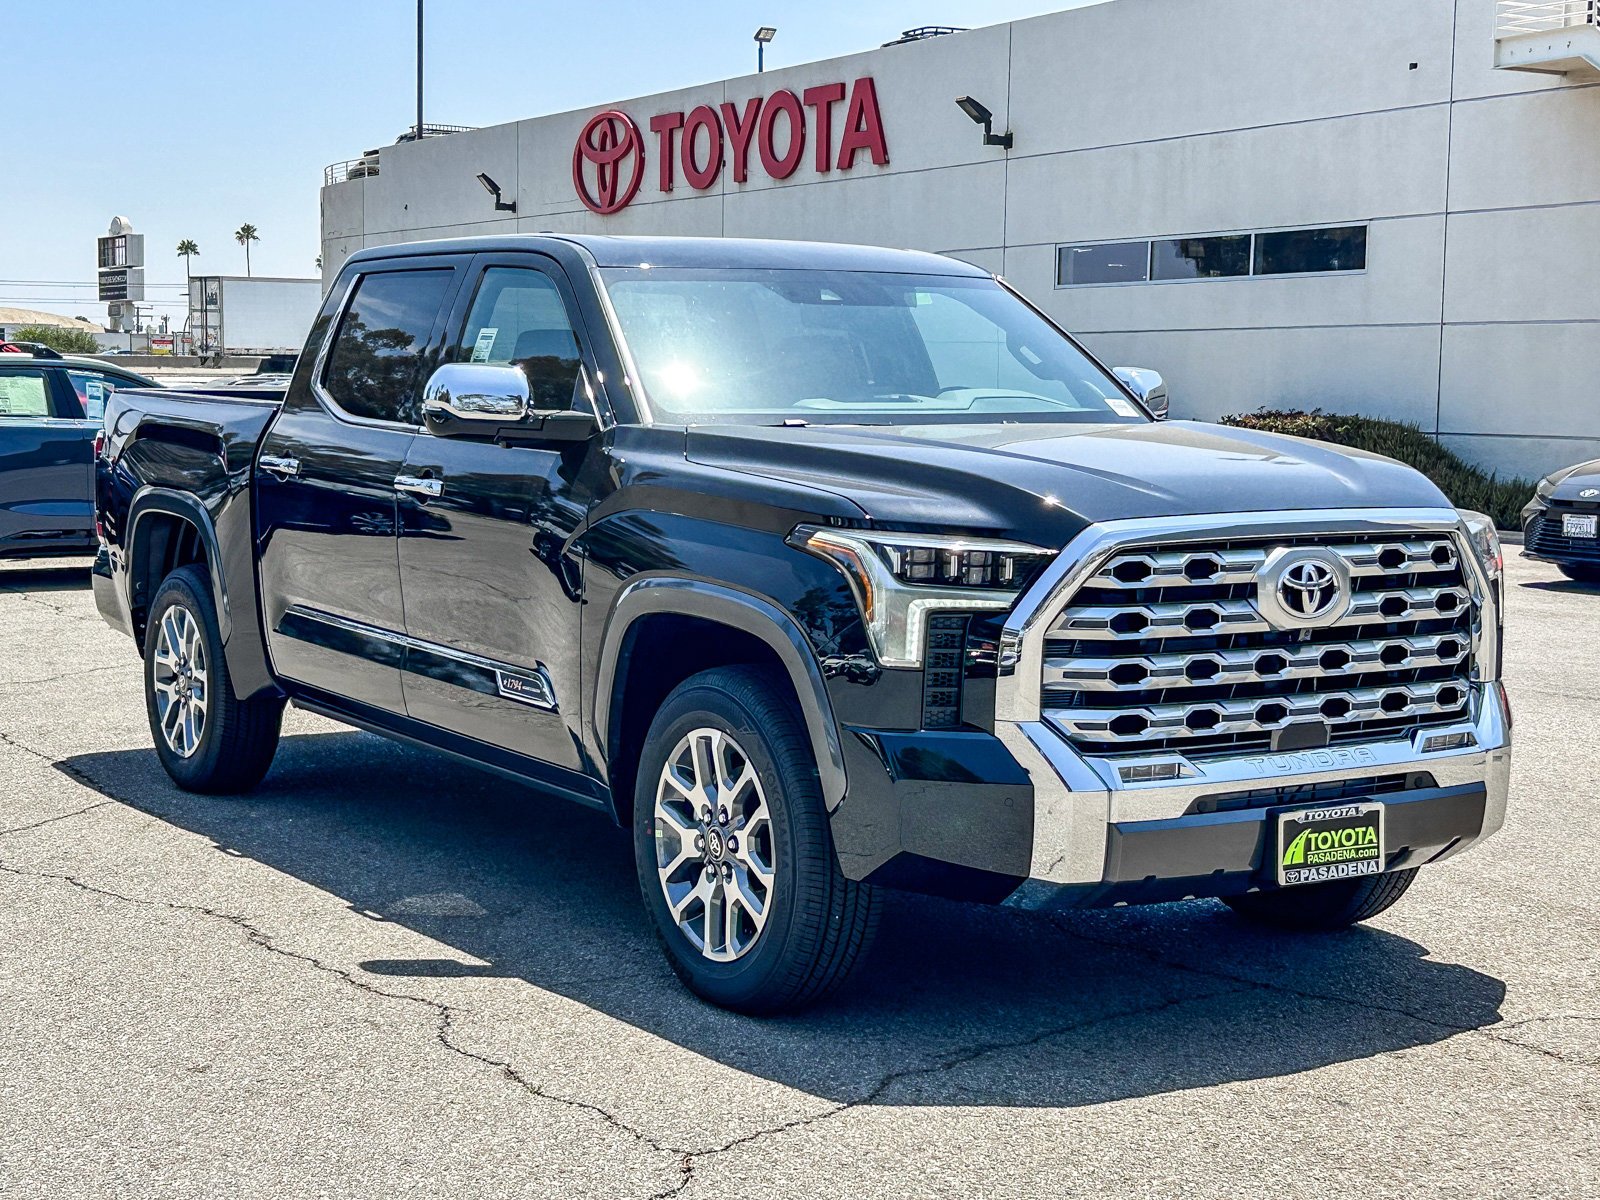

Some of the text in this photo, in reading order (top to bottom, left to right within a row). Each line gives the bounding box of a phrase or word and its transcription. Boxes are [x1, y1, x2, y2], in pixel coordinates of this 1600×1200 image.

[650, 77, 890, 192] TOYOTA
[1244, 747, 1377, 774] TUNDRA
[764, 761, 790, 870] YOKOHAMA
[1307, 807, 1356, 820] TOYOTA
[1308, 826, 1377, 850] TOYOTA
[1307, 848, 1378, 864] PASADENA.com
[1300, 861, 1378, 881] PASADENA
